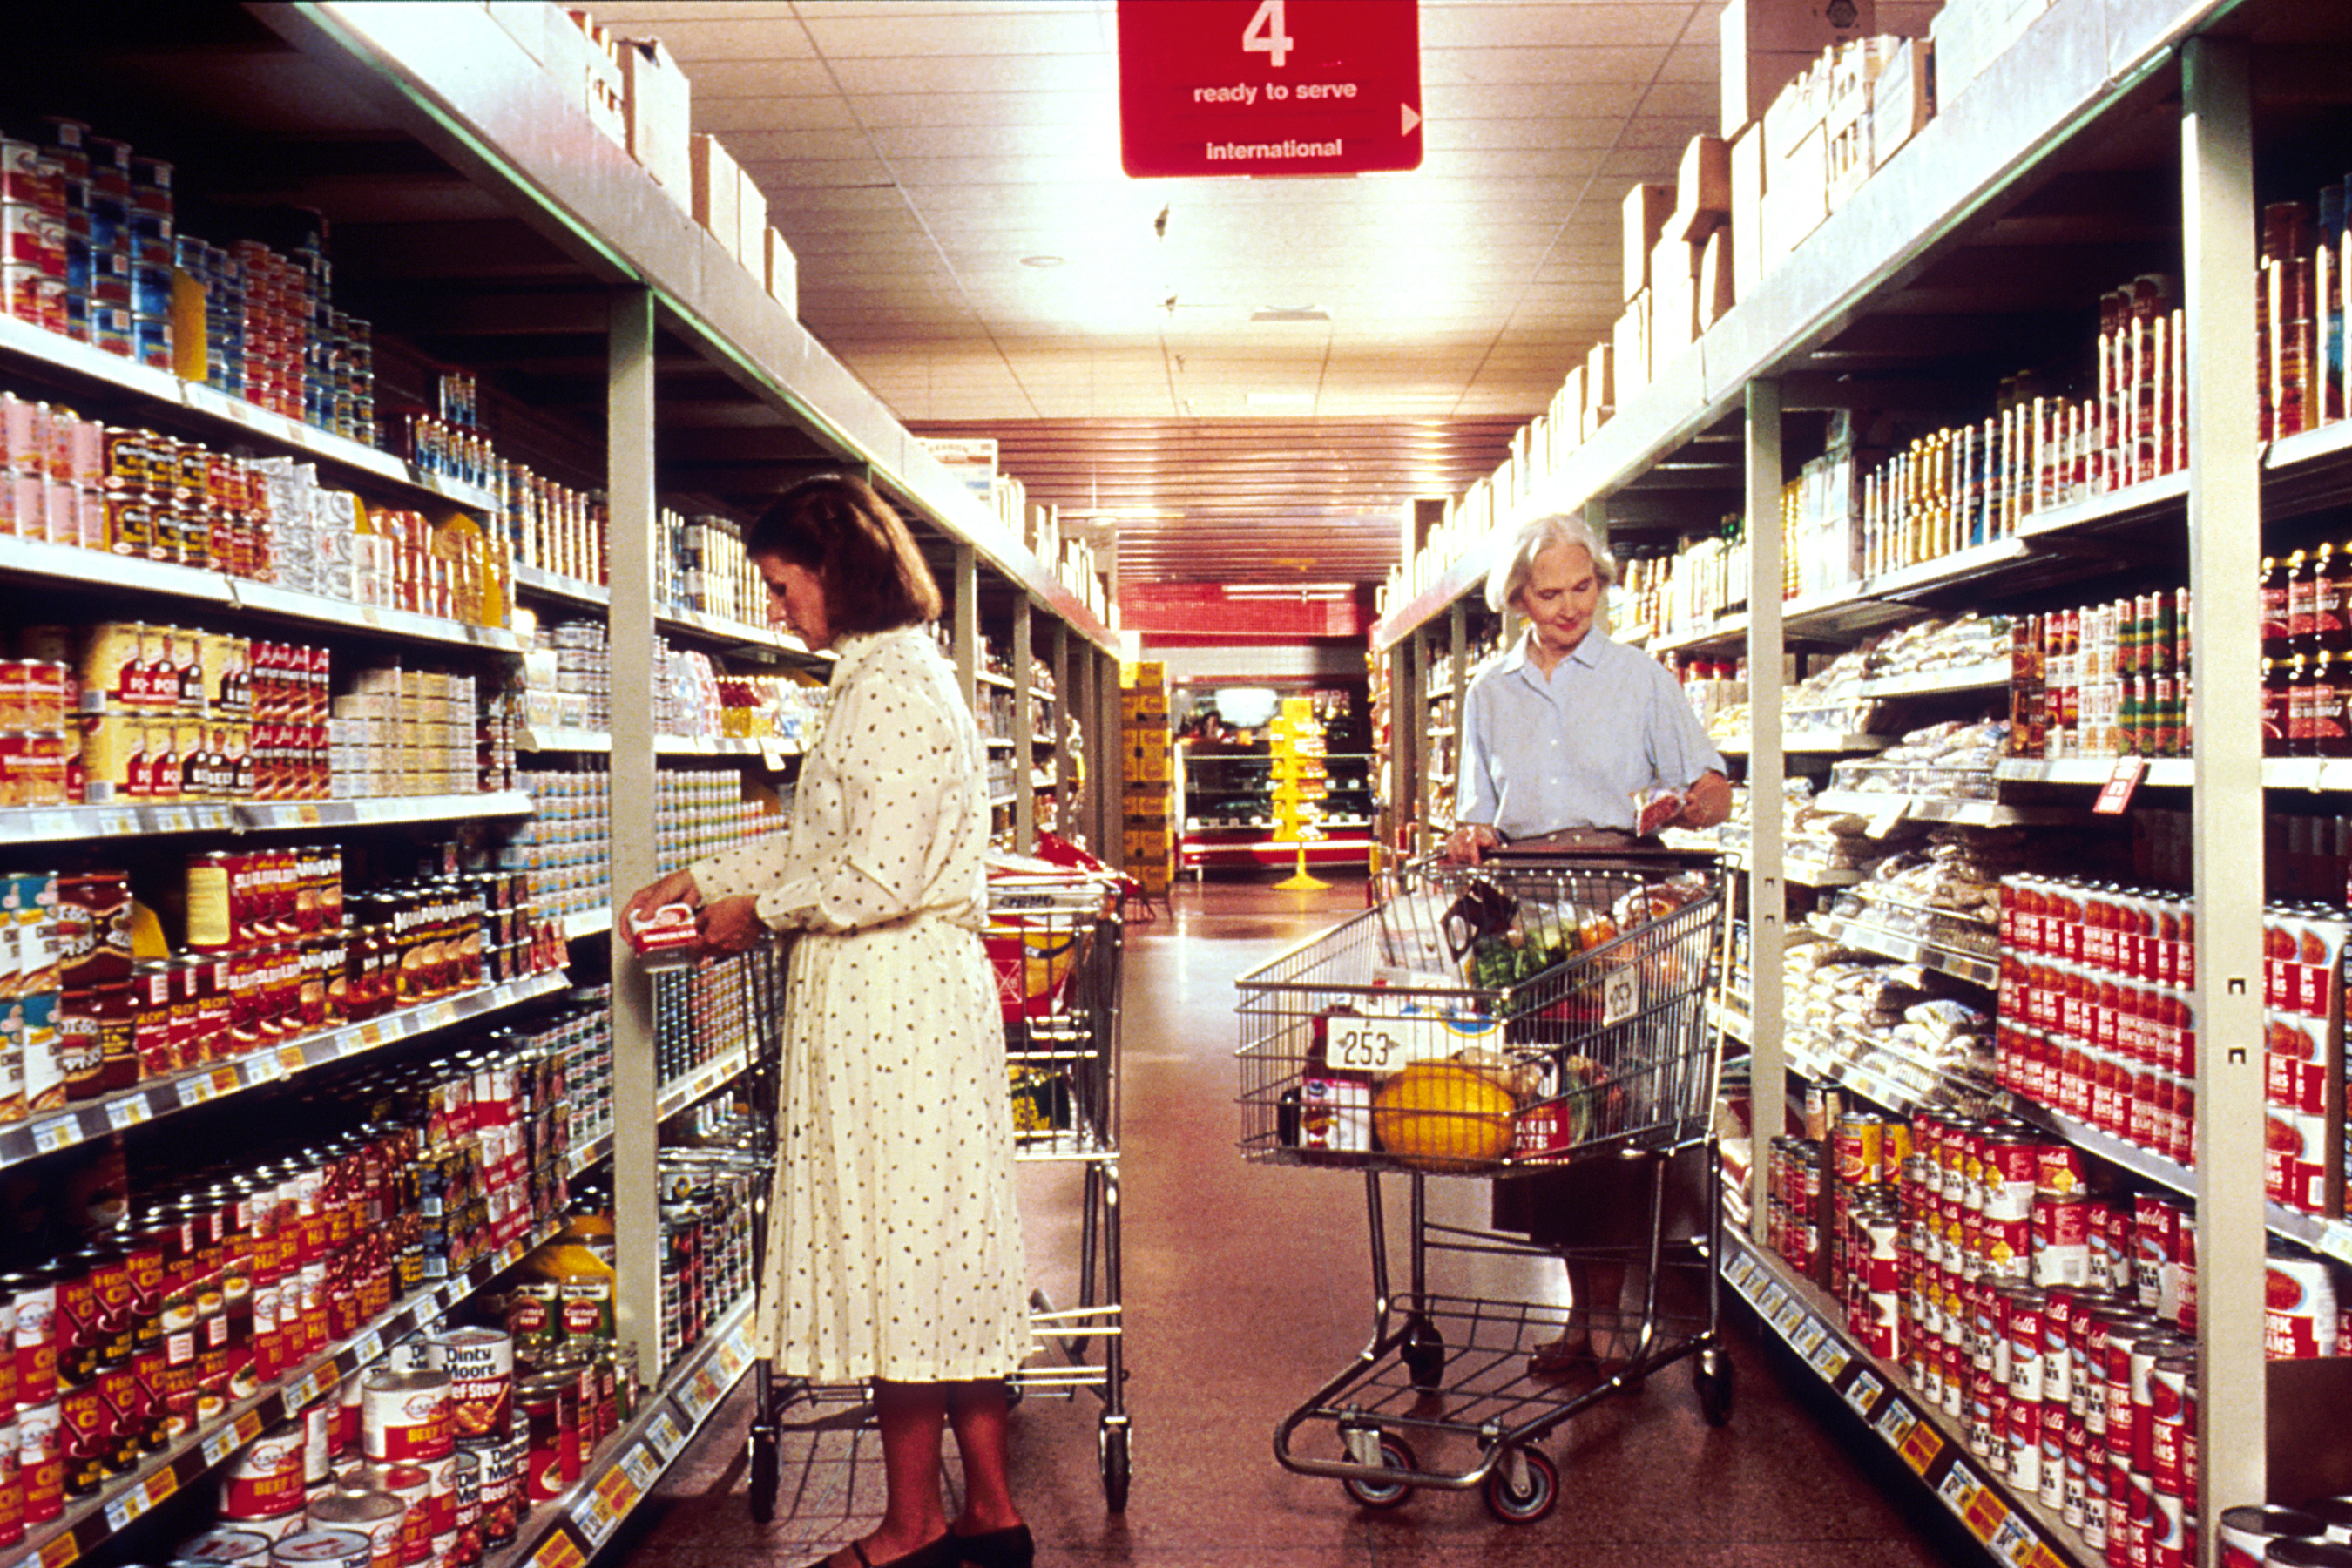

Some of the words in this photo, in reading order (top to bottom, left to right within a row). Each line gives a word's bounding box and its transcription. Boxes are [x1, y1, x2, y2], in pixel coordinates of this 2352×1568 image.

[1242, 0, 1294, 67] 4
[1193, 83, 1258, 105] ready
[1266, 83, 1289, 100] to
[1295, 83, 1358, 100] serve
[1206, 139, 1343, 160] international
[1343, 1031, 1389, 1067] 253
[563, 1308, 598, 1317] Corned
[570, 1316, 592, 1326] Beef
[445, 1346, 492, 1362] Dinty
[442, 1362, 497, 1379] Moore
[469, 1382, 502, 1398] Stew
